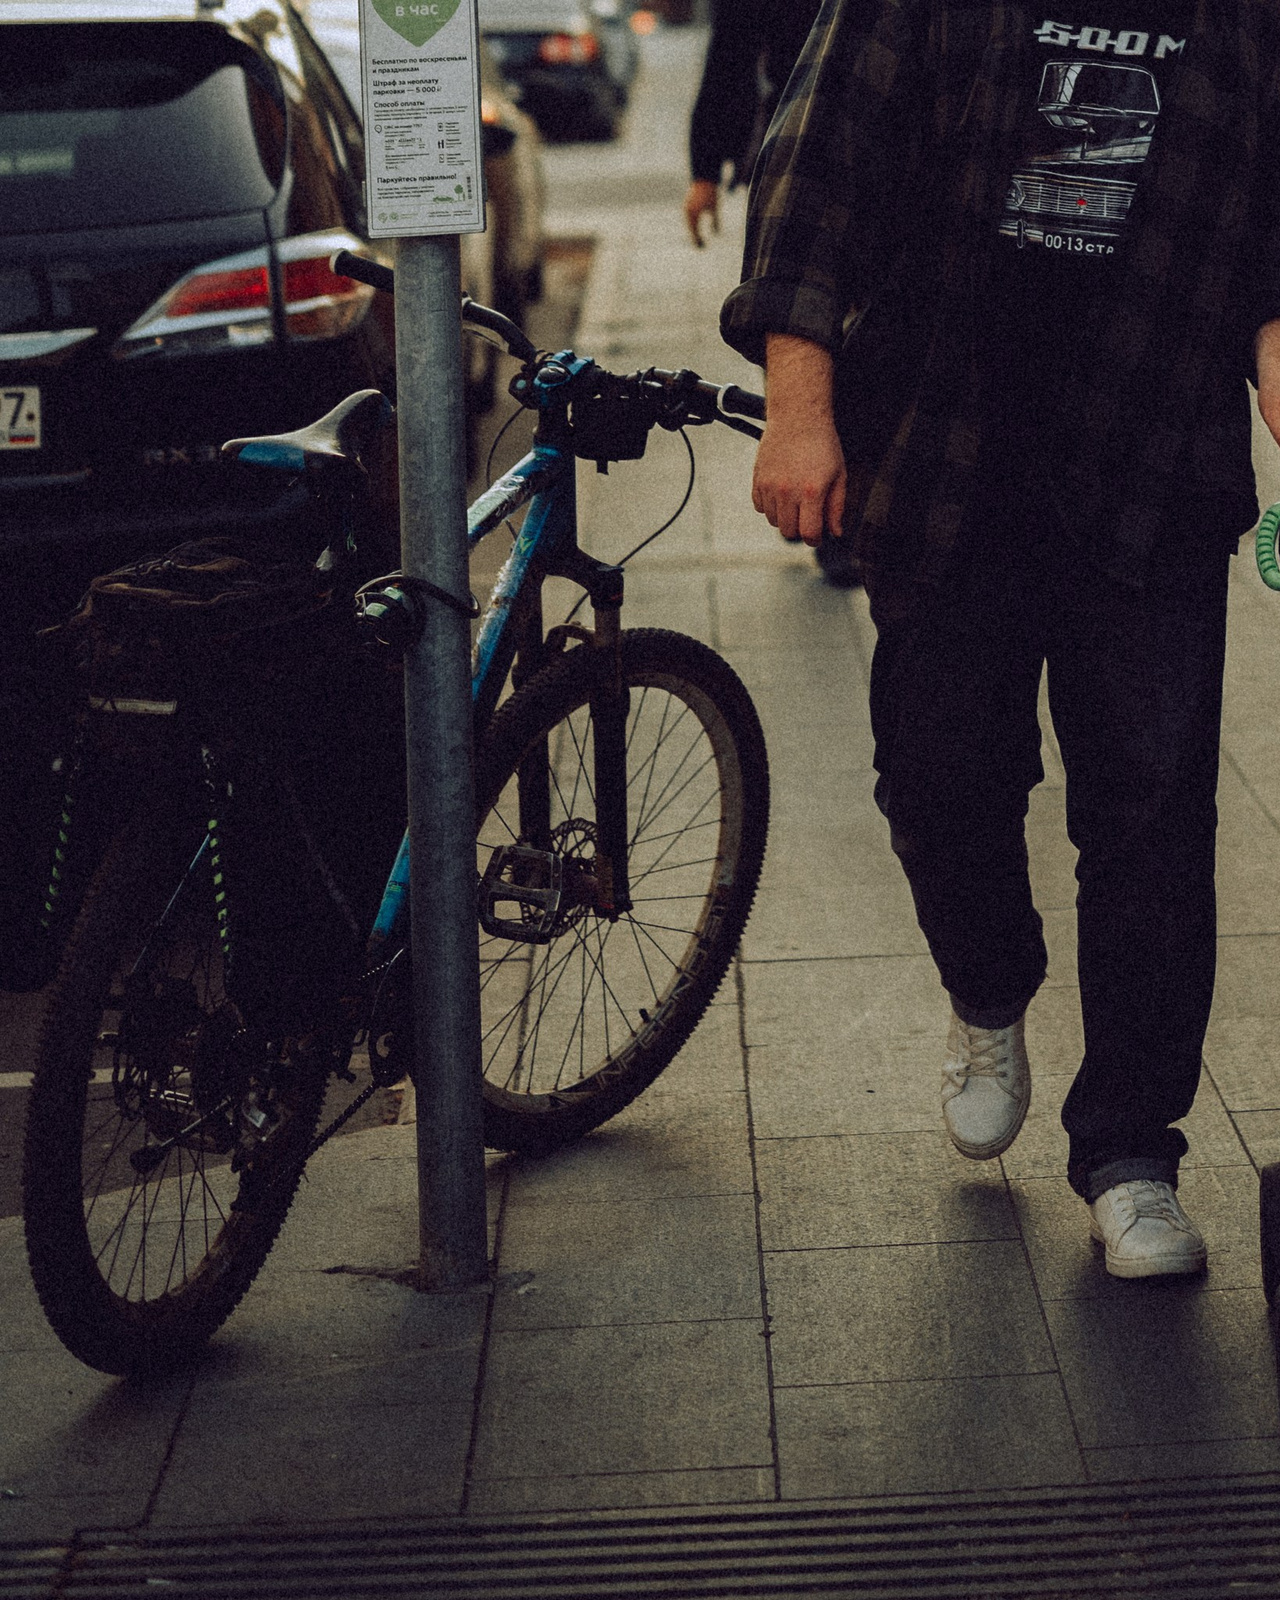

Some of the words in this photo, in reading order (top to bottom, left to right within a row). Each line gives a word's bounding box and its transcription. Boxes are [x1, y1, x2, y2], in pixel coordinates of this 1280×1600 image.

[395, 5, 405, 17] в
[409, 4, 439, 16] час
[419, 56, 468, 64] воскресеньям
[377, 176, 418, 184] Паркуйтесь
[418, 173, 457, 181] правильно!
